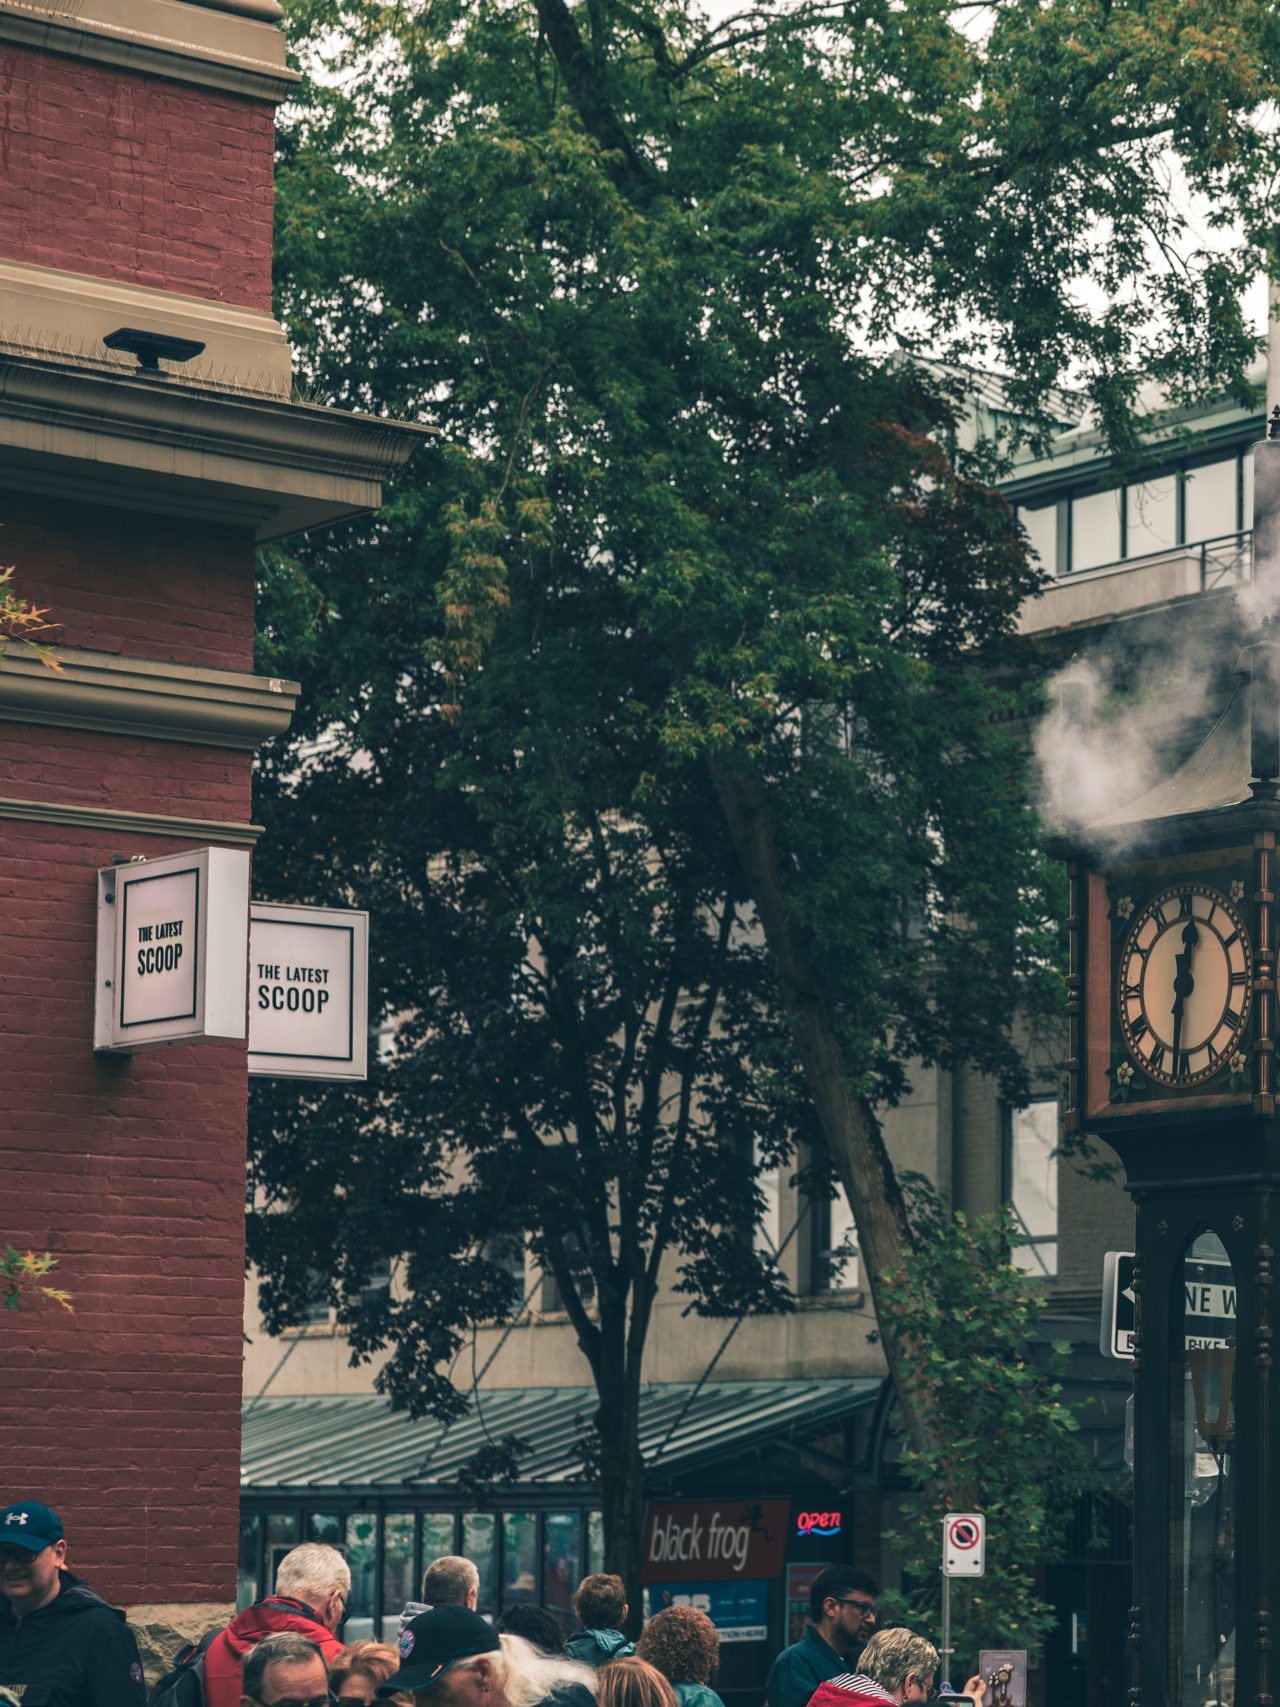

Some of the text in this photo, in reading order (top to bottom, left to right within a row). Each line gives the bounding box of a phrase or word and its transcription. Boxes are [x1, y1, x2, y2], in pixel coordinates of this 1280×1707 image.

[138, 920, 184, 943] THE LATEST
[137, 943, 183, 976] SCOOP
[257, 963, 330, 984] THE LATEST
[258, 985, 330, 1014] SCOOP
[649, 1512, 750, 1571] black frog
